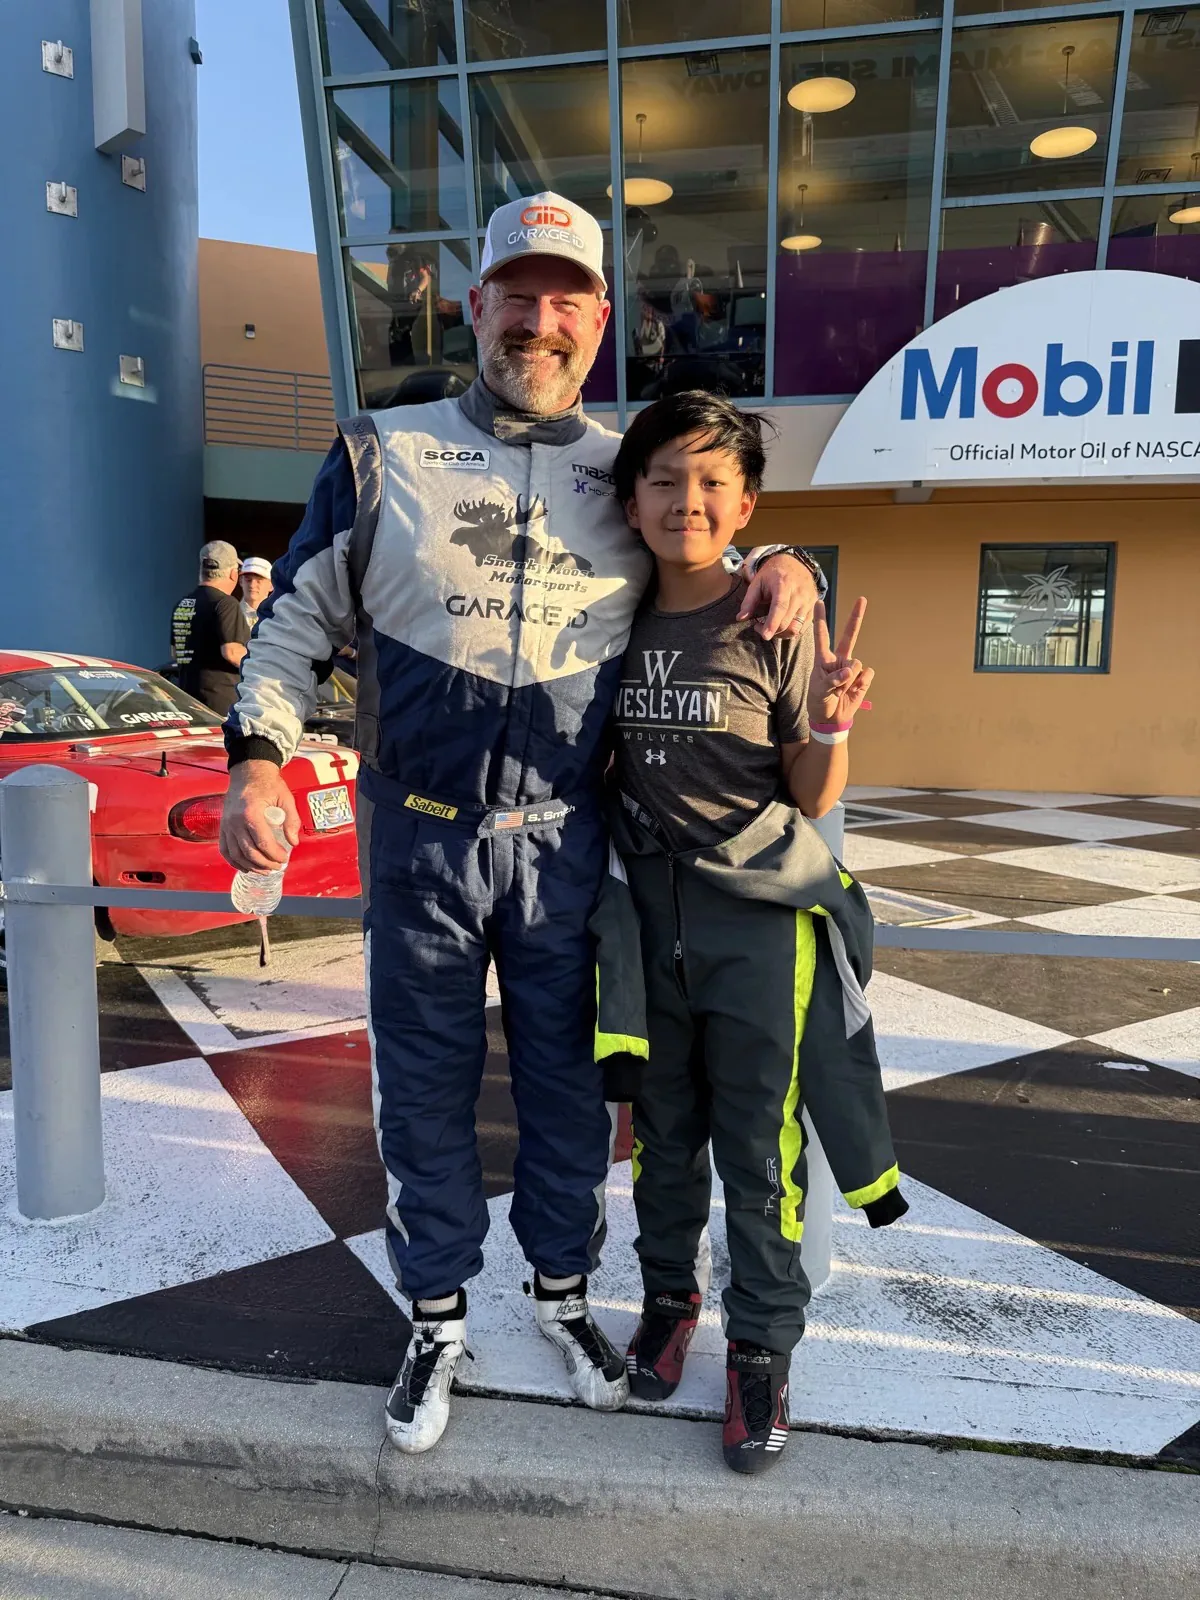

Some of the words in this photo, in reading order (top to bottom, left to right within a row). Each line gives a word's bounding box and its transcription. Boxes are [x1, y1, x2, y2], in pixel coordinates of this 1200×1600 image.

[507, 228, 571, 245] GARAGE
[901, 340, 1154, 420] Mobil
[423, 450, 485, 462] SCCA
[950, 443, 1015, 461] Official
[1020, 443, 1076, 459] Motor
[1081, 441, 1106, 458] Oil
[1111, 441, 1131, 458] of
[484, 554, 545, 574] Sneaky
[546, 562, 596, 579] Moose
[488, 570, 589, 594] Motorsports
[642, 650, 683, 688] W
[623, 731, 694, 743] WOLVES
[409, 796, 452, 817] Sabelt
